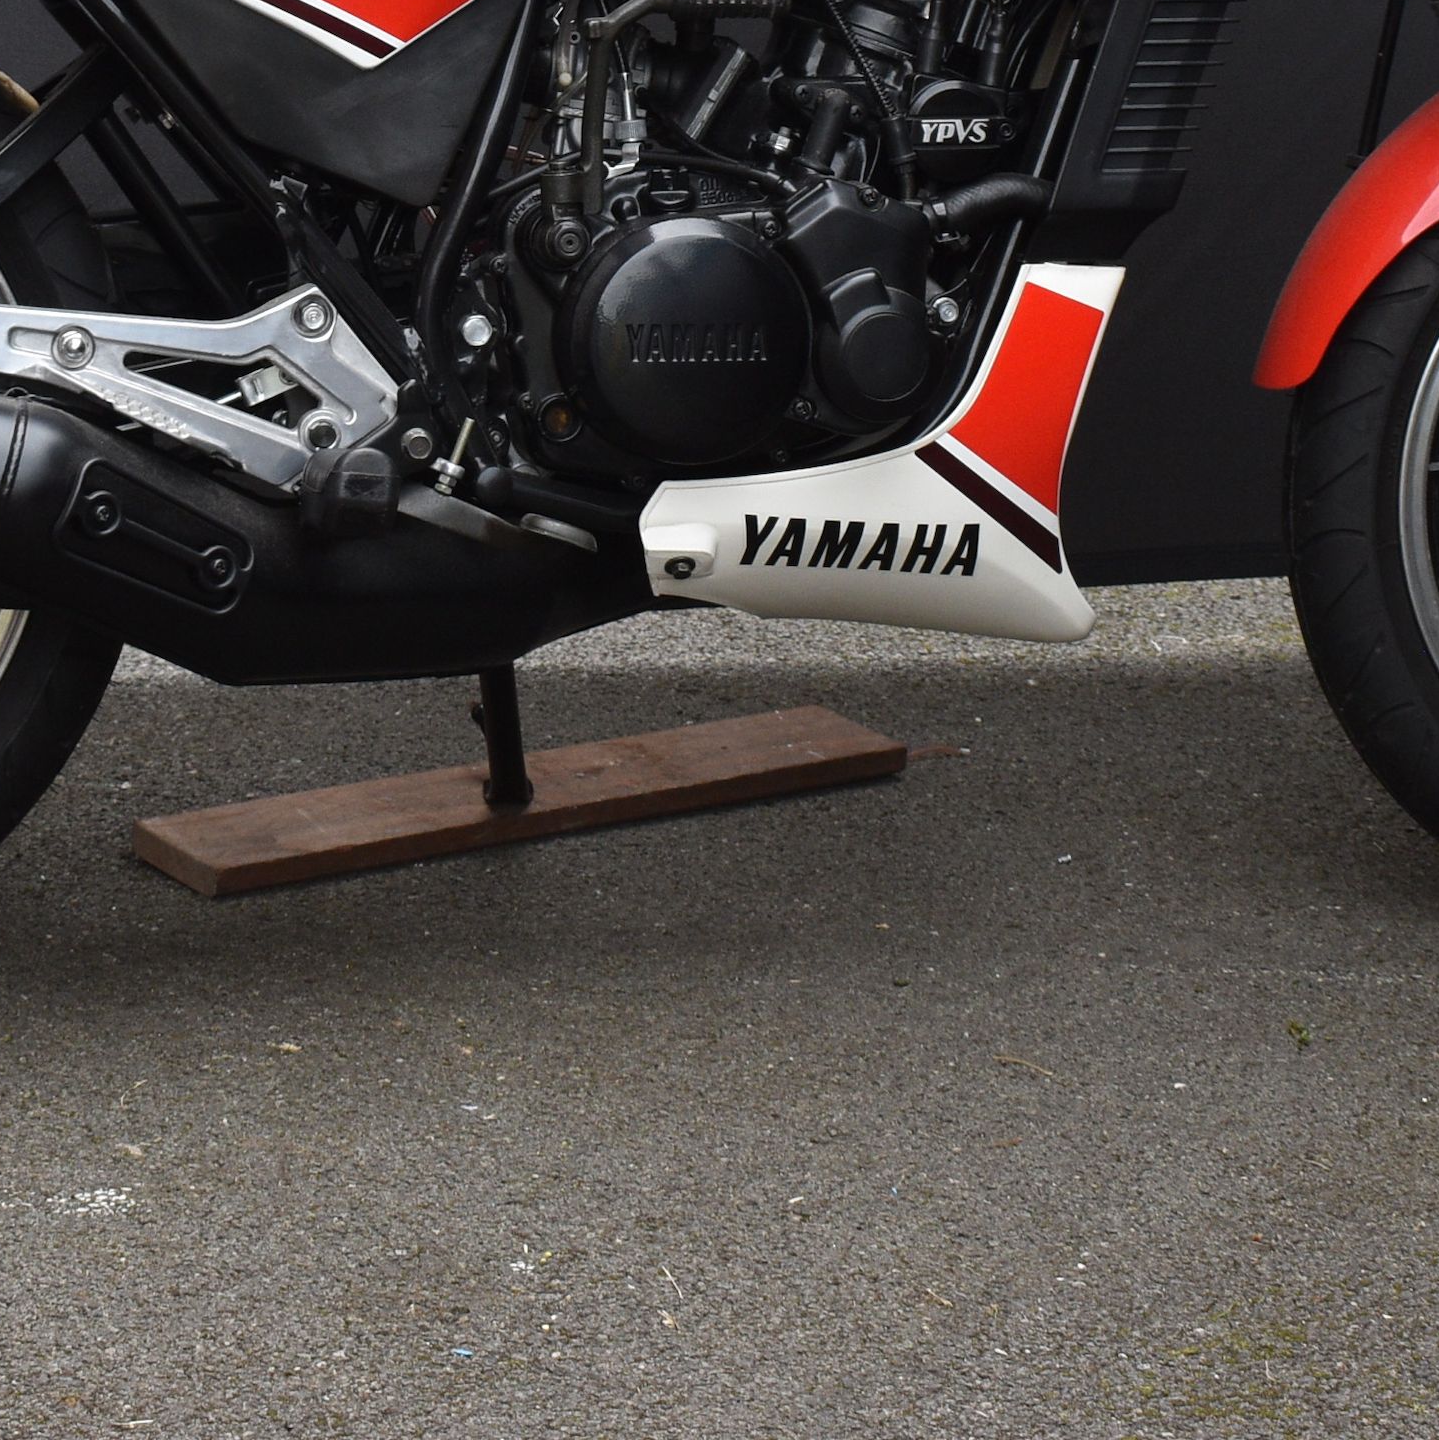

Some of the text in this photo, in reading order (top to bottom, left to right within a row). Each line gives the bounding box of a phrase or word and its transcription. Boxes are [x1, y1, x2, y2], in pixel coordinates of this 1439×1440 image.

[921, 118, 989, 144] YPVS
[625, 323, 767, 362] YAMAHA
[739, 514, 980, 577] YAMAHA
